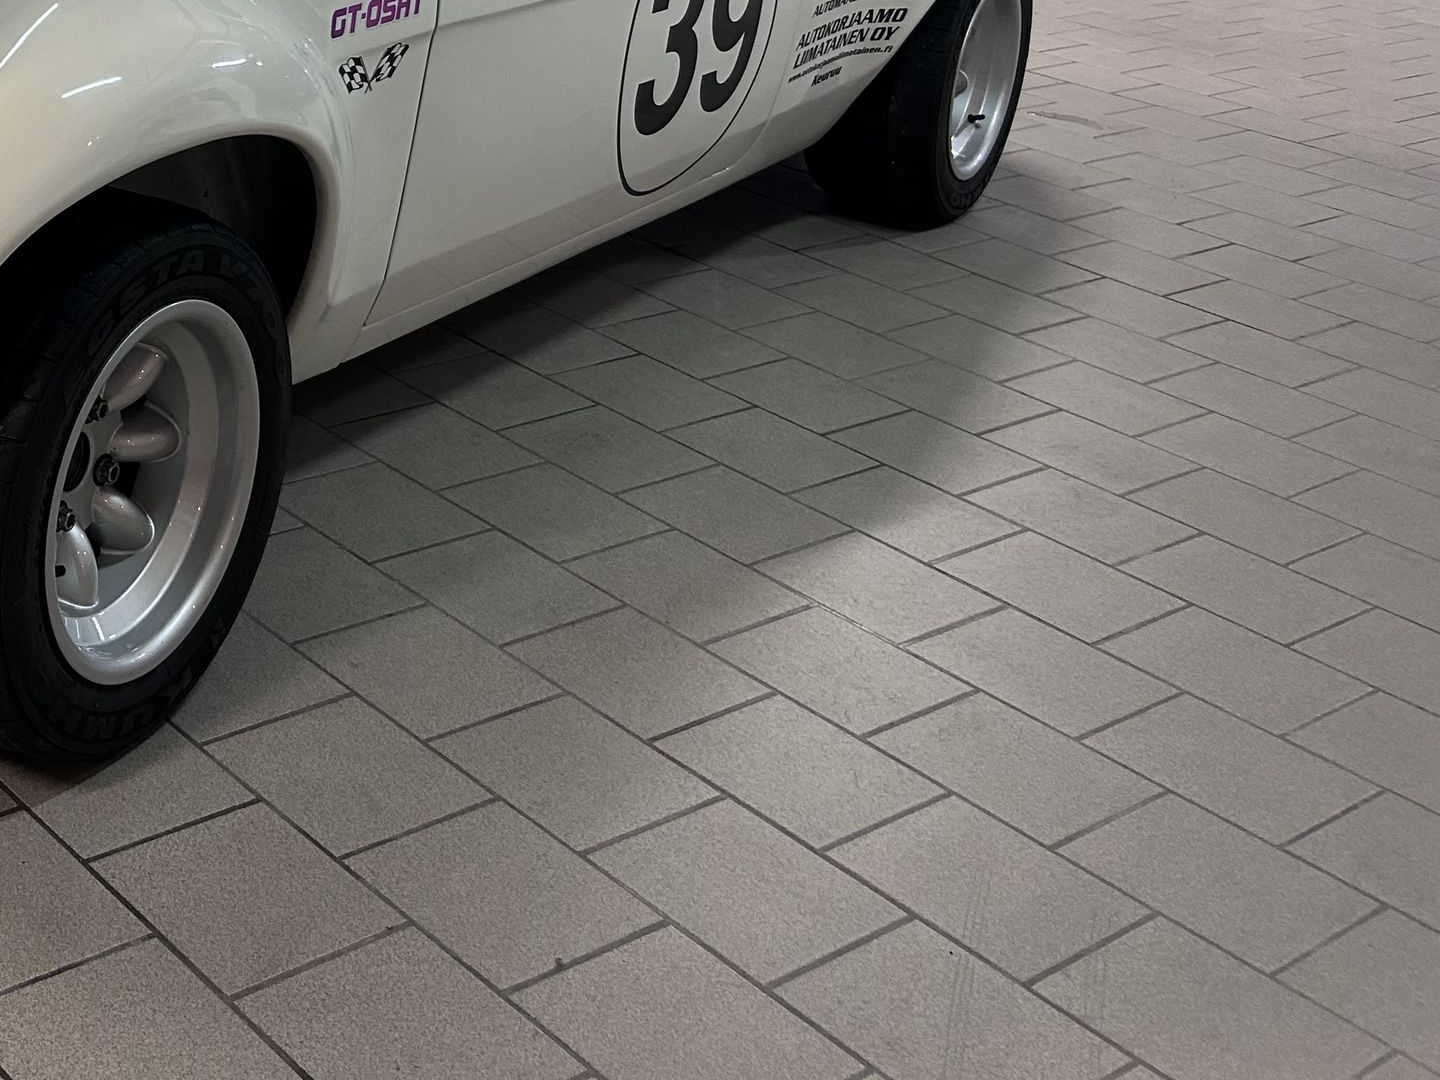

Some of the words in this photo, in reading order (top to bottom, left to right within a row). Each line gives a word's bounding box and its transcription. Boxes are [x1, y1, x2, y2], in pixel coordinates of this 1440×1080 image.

[793, 27, 870, 69] LIIMATAINEN
[870, 26, 900, 41] OY
[796, 8, 908, 51] AUTOKORJAAMO
[811, 66, 843, 87] Keuruu
